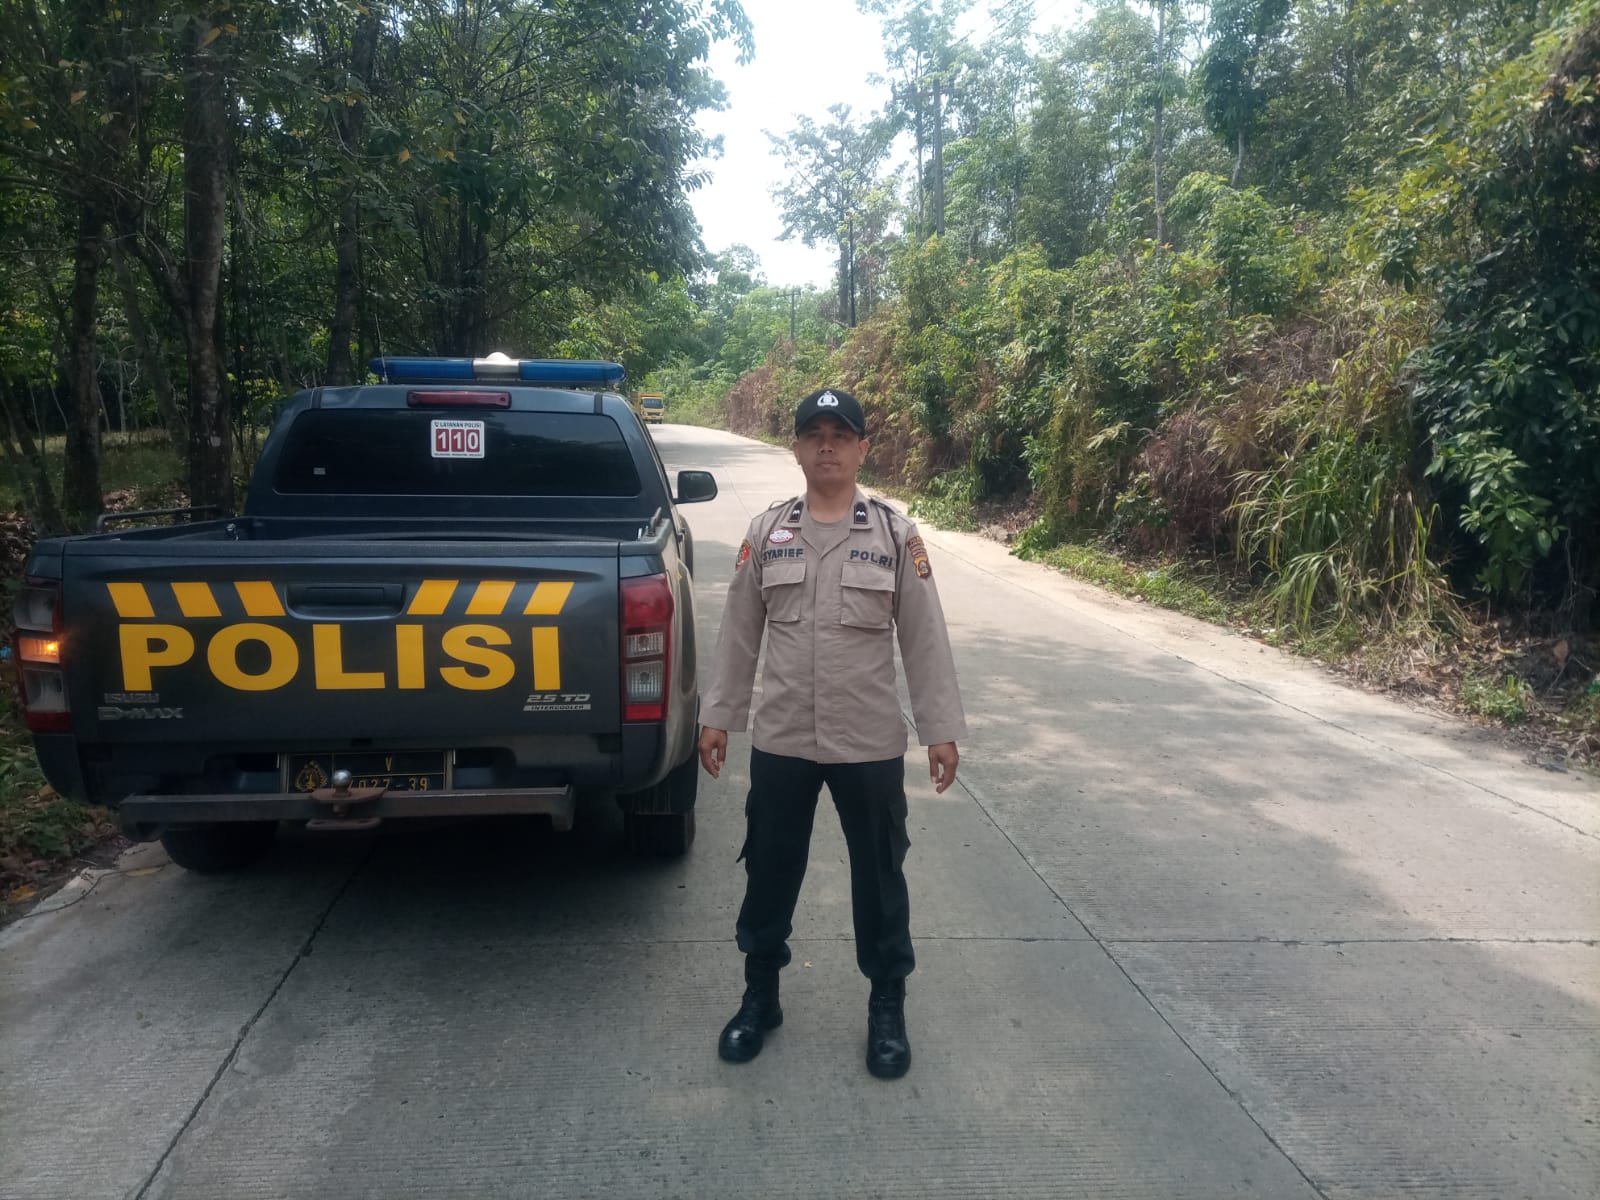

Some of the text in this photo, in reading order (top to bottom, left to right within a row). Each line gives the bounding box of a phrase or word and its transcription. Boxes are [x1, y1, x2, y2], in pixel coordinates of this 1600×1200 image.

[437, 431, 479, 450] 110
[763, 548, 804, 561] SYARIEF
[850, 549, 893, 567] POLRI
[119, 622, 561, 691] POLISI
[560, 694, 591, 702] TD
[385, 756, 392, 771] V
